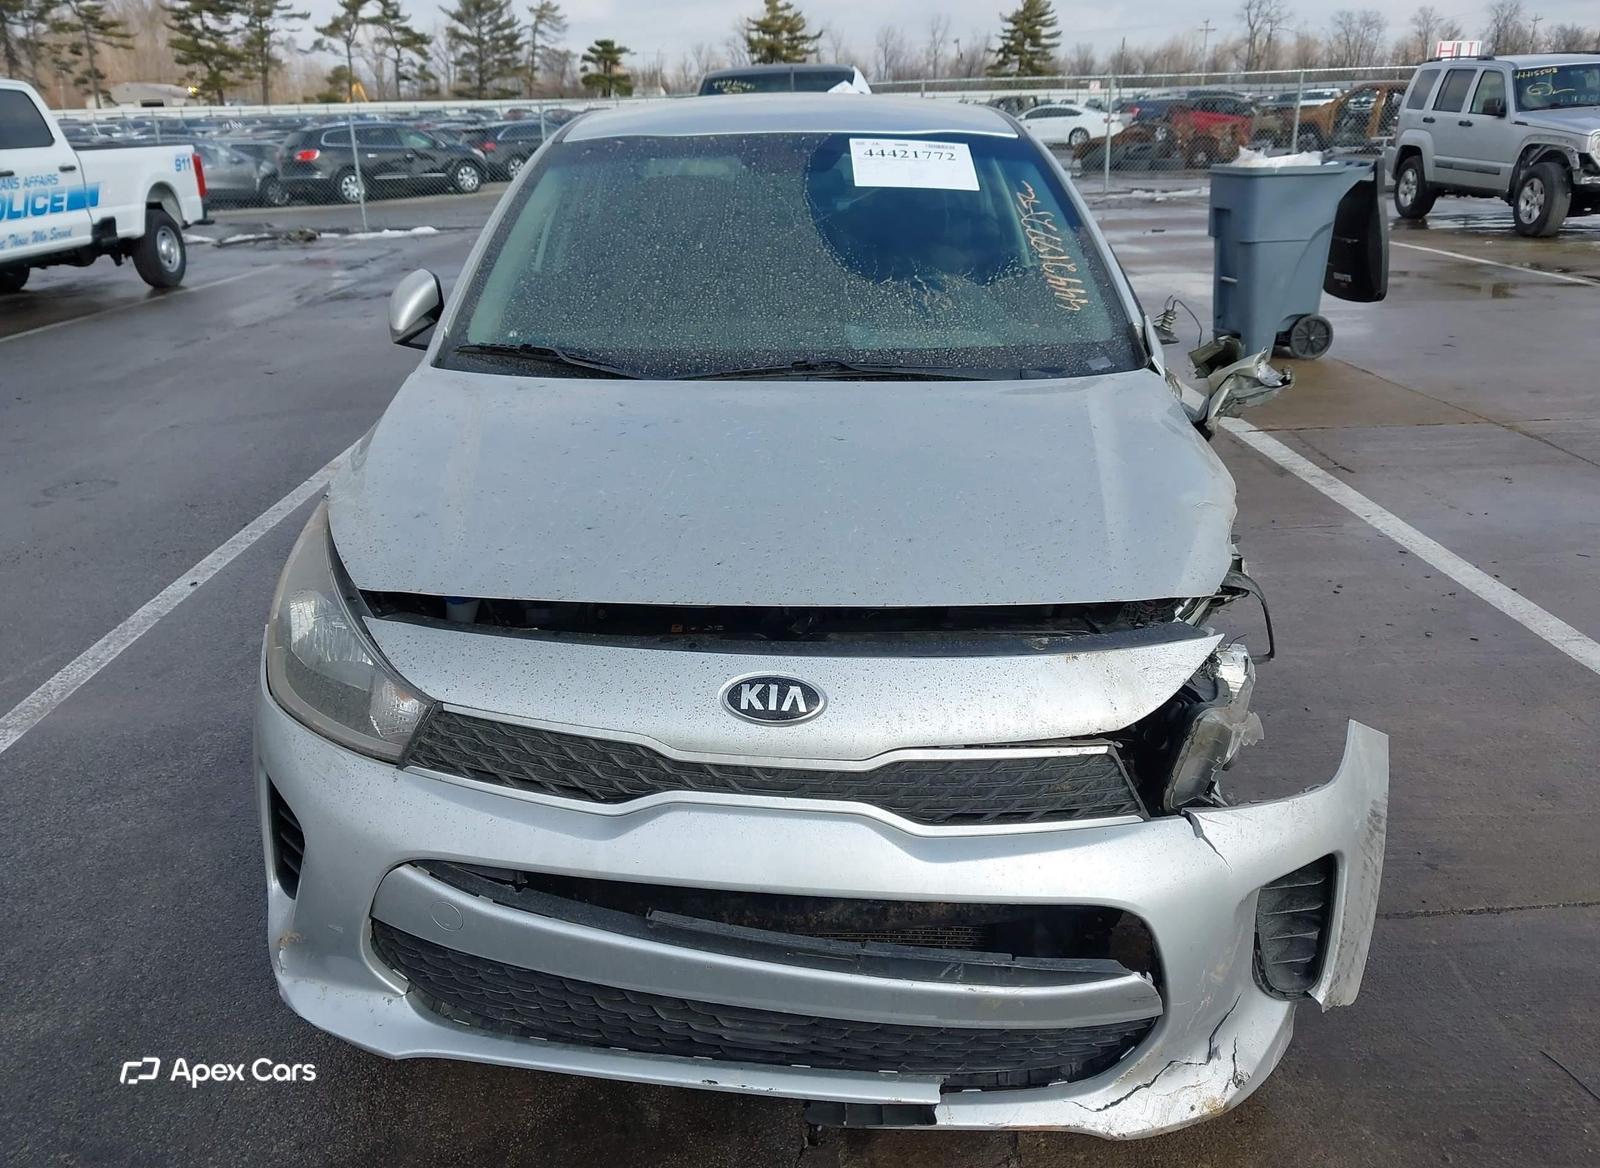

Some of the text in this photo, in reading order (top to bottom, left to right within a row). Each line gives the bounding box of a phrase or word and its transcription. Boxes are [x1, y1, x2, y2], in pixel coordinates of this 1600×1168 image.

[863, 148, 956, 161] 44421772
[175, 158, 191, 172] 911
[22, 173, 59, 187] AFFAIRS
[740, 683, 807, 712] KIA
